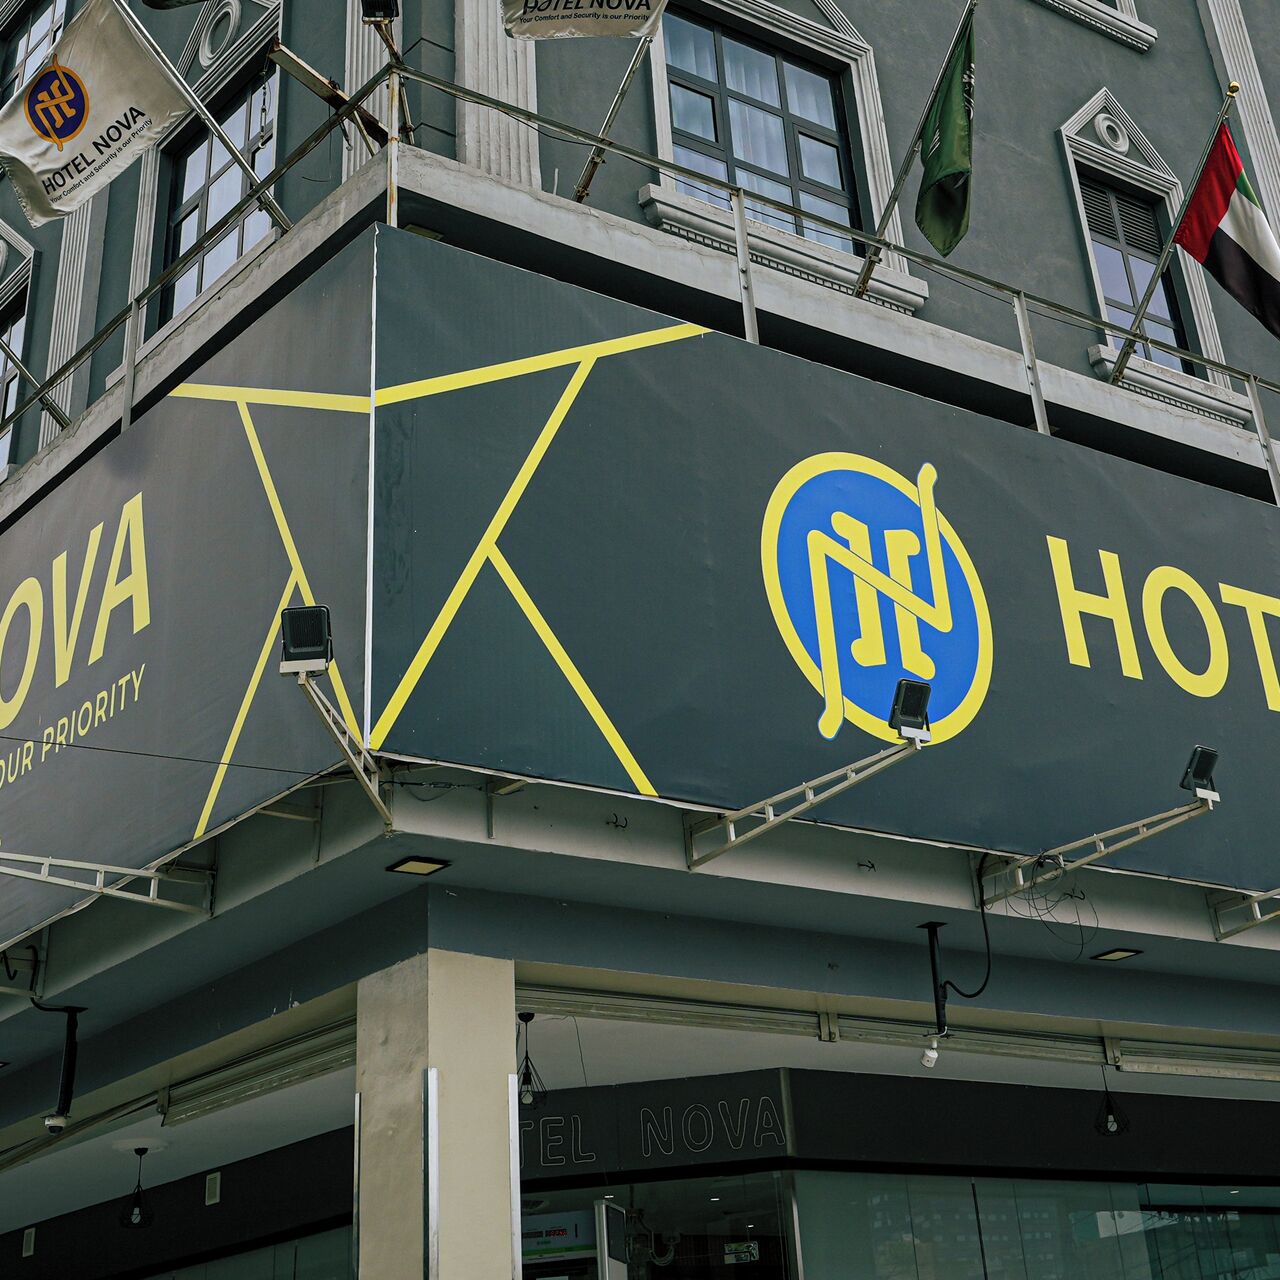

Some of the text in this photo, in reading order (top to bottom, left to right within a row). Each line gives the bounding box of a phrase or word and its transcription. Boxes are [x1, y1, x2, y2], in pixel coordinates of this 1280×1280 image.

[573, 12, 601, 20] Security
[624, 13, 650, 21] Priority
[41, 106, 146, 195] HOTEL NOVA
[50, 118, 153, 204] Your Comfort and Security is our Priority
[41, 663, 145, 762] PRIORITY
[640, 1096, 786, 1158] NOVA
